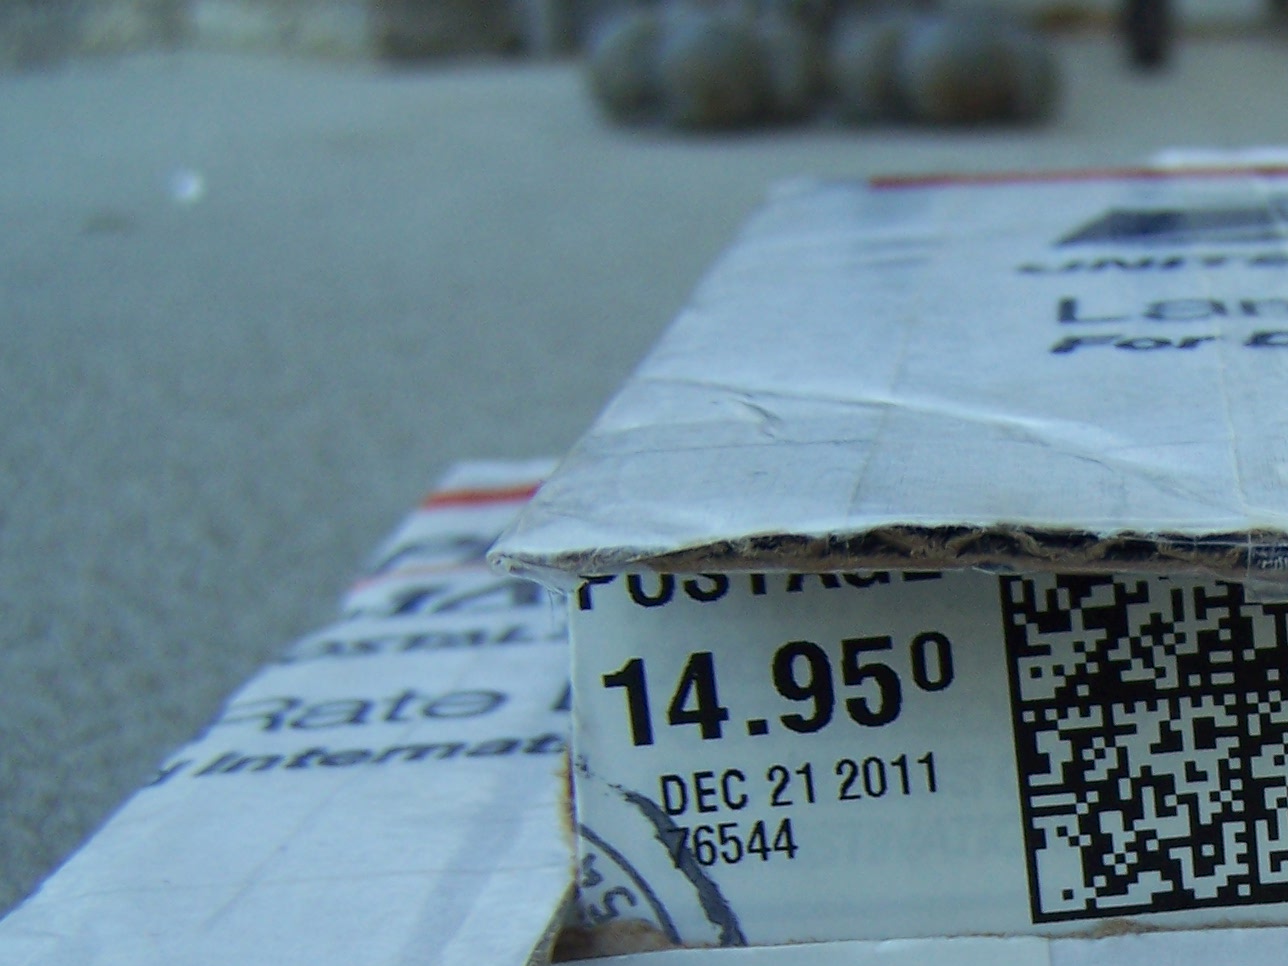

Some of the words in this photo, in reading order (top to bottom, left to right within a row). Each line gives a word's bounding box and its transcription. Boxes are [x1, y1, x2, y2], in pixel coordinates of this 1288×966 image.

[1051, 332, 1220, 354] For
[221, 688, 508, 732] Rate
[660, 767, 748, 816] DEC
[766, 762, 816, 808] 21
[835, 751, 938, 801] 2011
[666, 817, 800, 869] 76544
